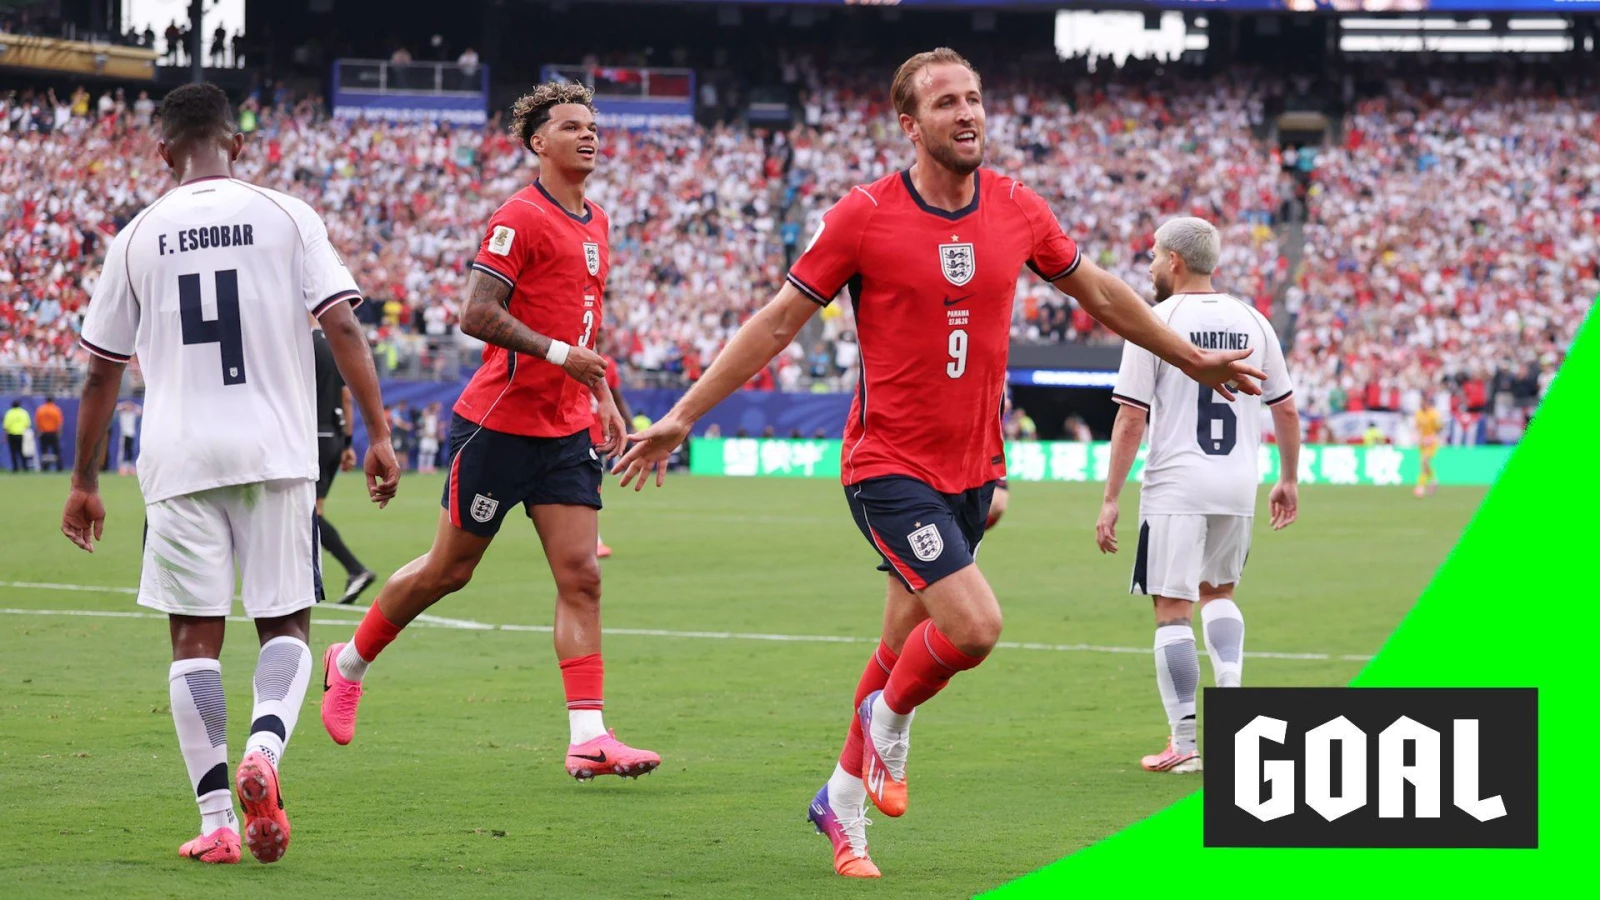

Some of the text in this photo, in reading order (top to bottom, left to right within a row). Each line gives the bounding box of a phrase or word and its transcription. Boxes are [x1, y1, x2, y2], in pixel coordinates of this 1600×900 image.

[158, 224, 254, 256] F. ESCOBAR
[178, 268, 247, 386] 4
[578, 310, 594, 348] 3
[946, 309, 970, 318] PANAMA
[946, 329, 970, 379] 9
[1189, 328, 1250, 350] MARTÍNEZ
[1197, 381, 1237, 456] 6
